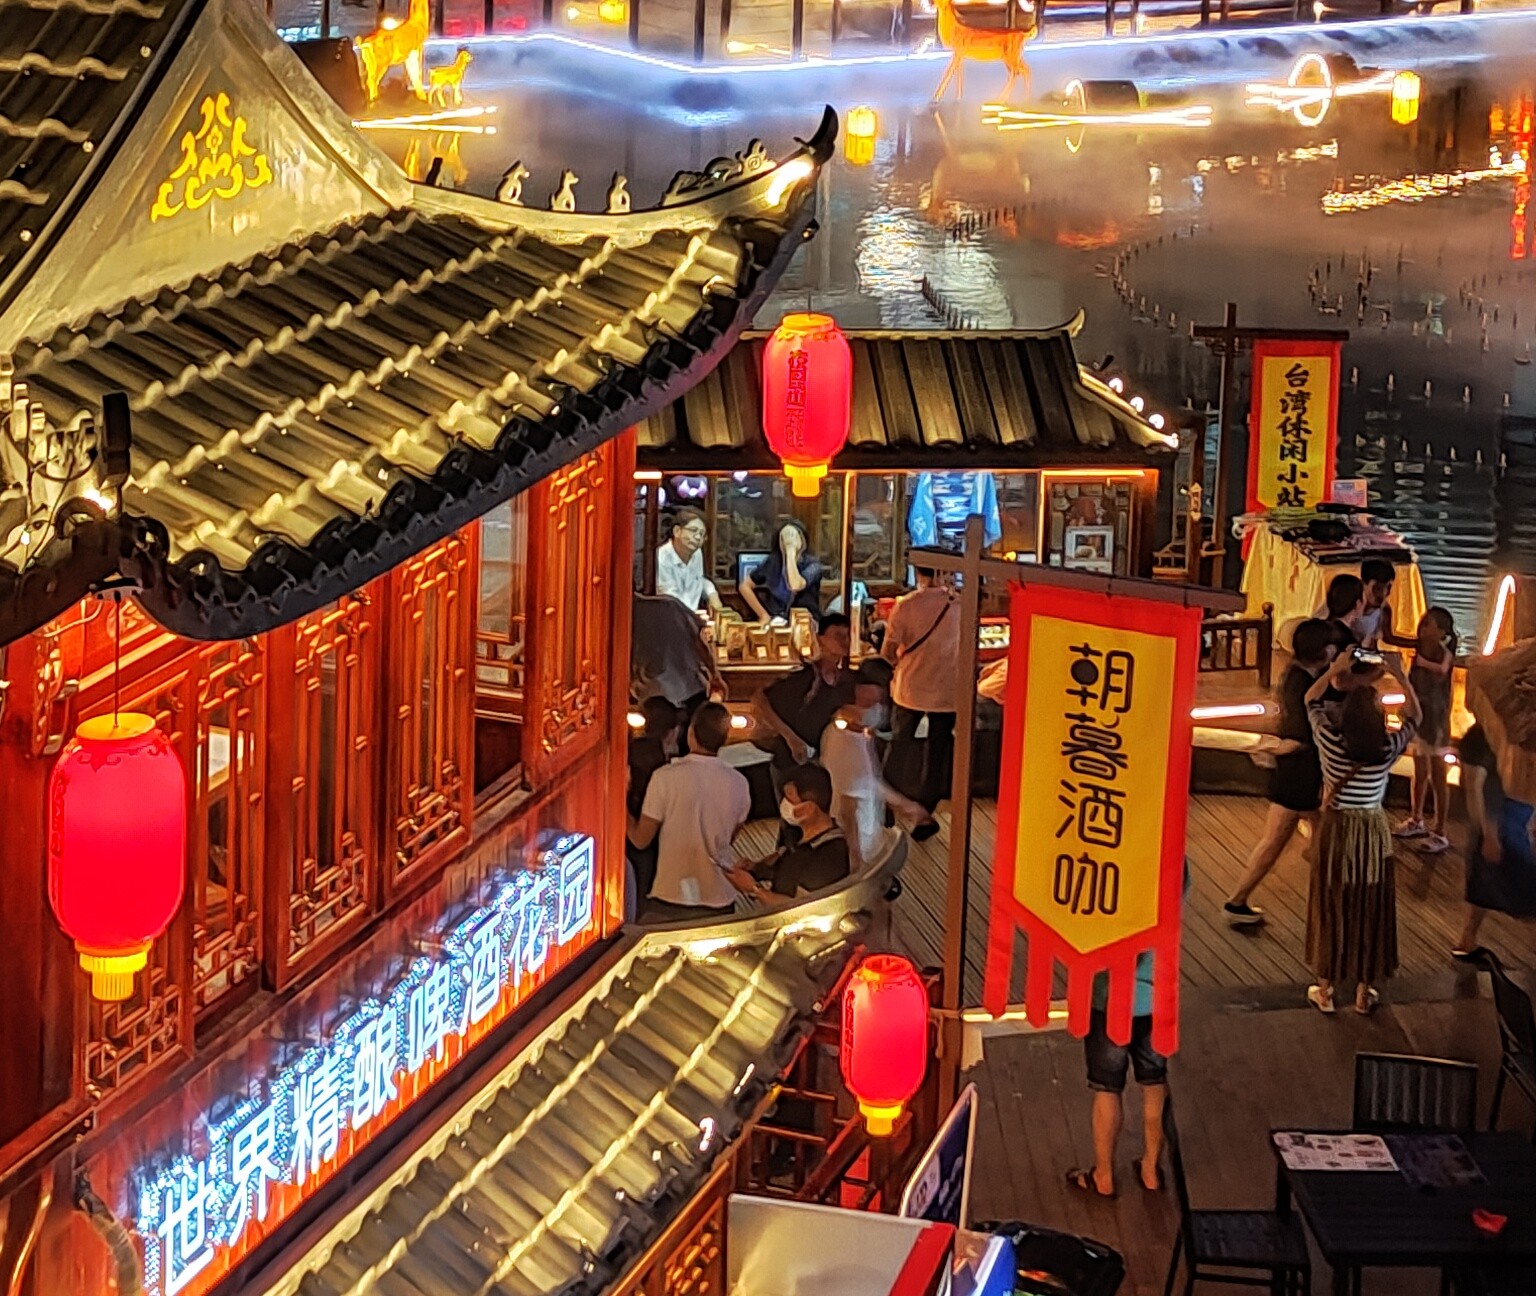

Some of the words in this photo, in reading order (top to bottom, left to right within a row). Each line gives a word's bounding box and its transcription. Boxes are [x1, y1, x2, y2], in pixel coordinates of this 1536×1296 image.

[1275, 362, 1313, 508] 台湾休闲小站
[1052, 641, 1136, 917] 朝暮酒咖
[159, 834, 596, 1296] 世界精酿啤酒花园
